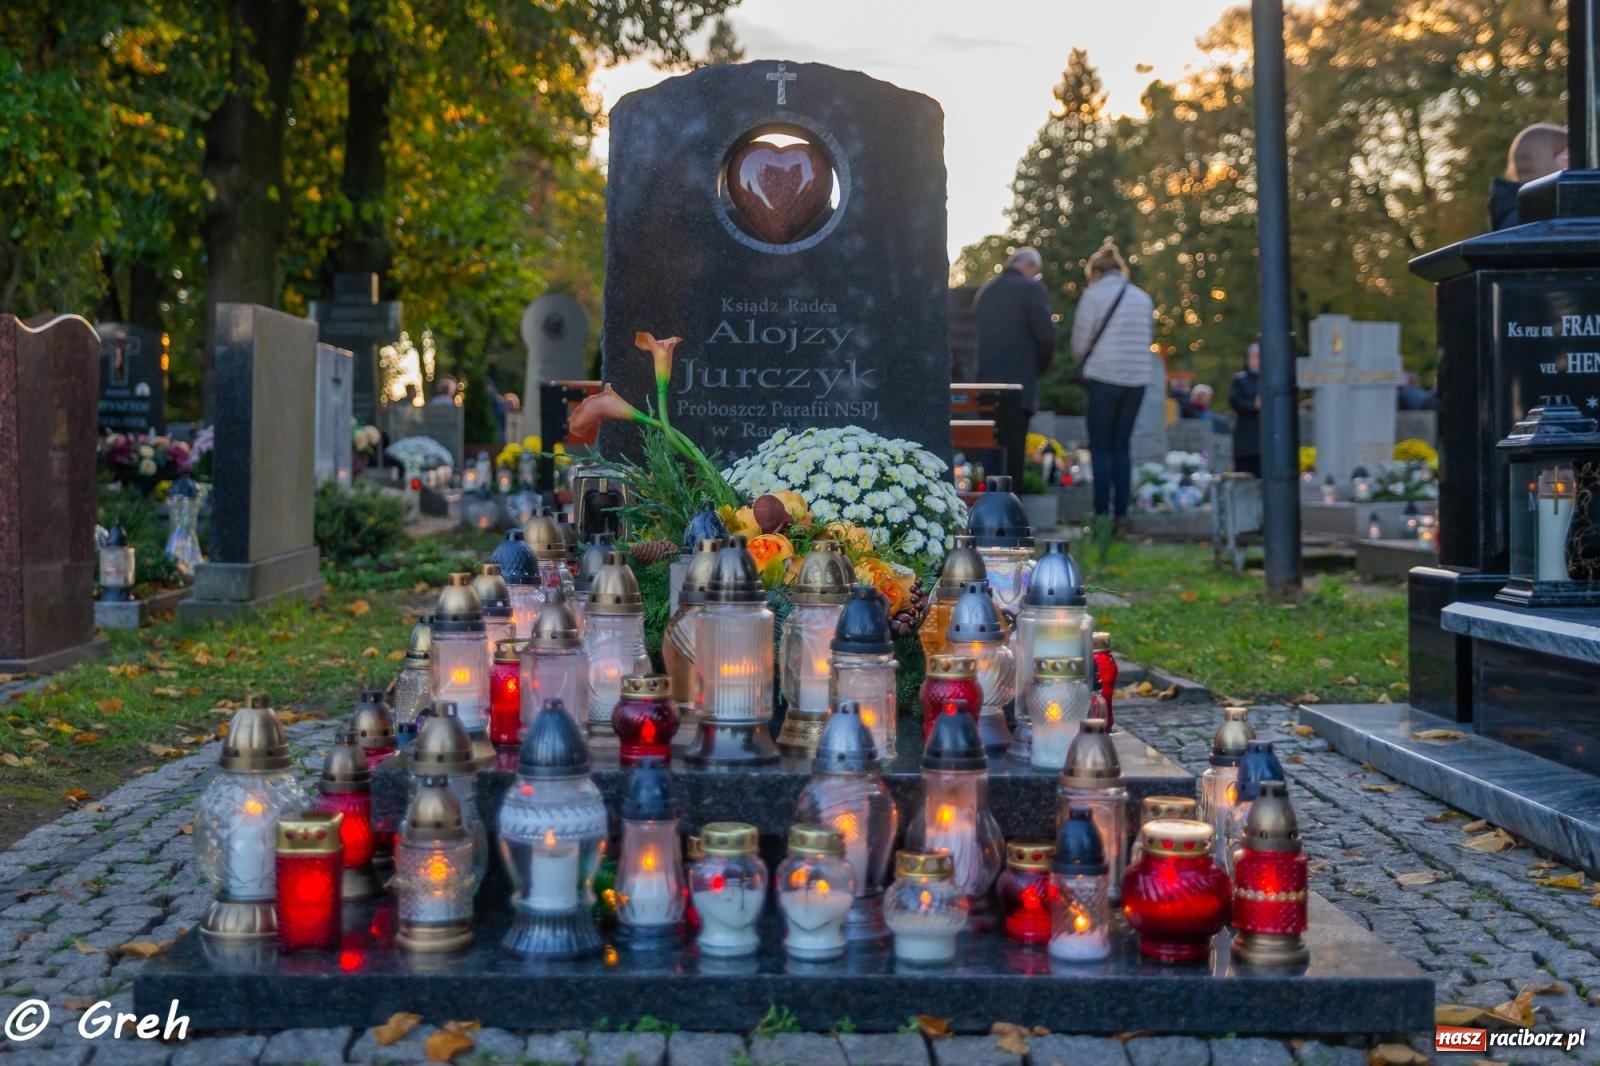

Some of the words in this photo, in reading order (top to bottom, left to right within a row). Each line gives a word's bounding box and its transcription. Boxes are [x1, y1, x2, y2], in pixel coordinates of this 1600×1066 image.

[721, 297, 778, 316] Ksiądz
[788, 298, 838, 313] Radca
[705, 319, 855, 353] Alojzy
[678, 358, 878, 399] Jurczyk
[677, 400, 766, 417] Proboszcz
[771, 400, 829, 417] Parafii
[834, 401, 880, 421] NSPJ
[711, 425, 729, 438] w
